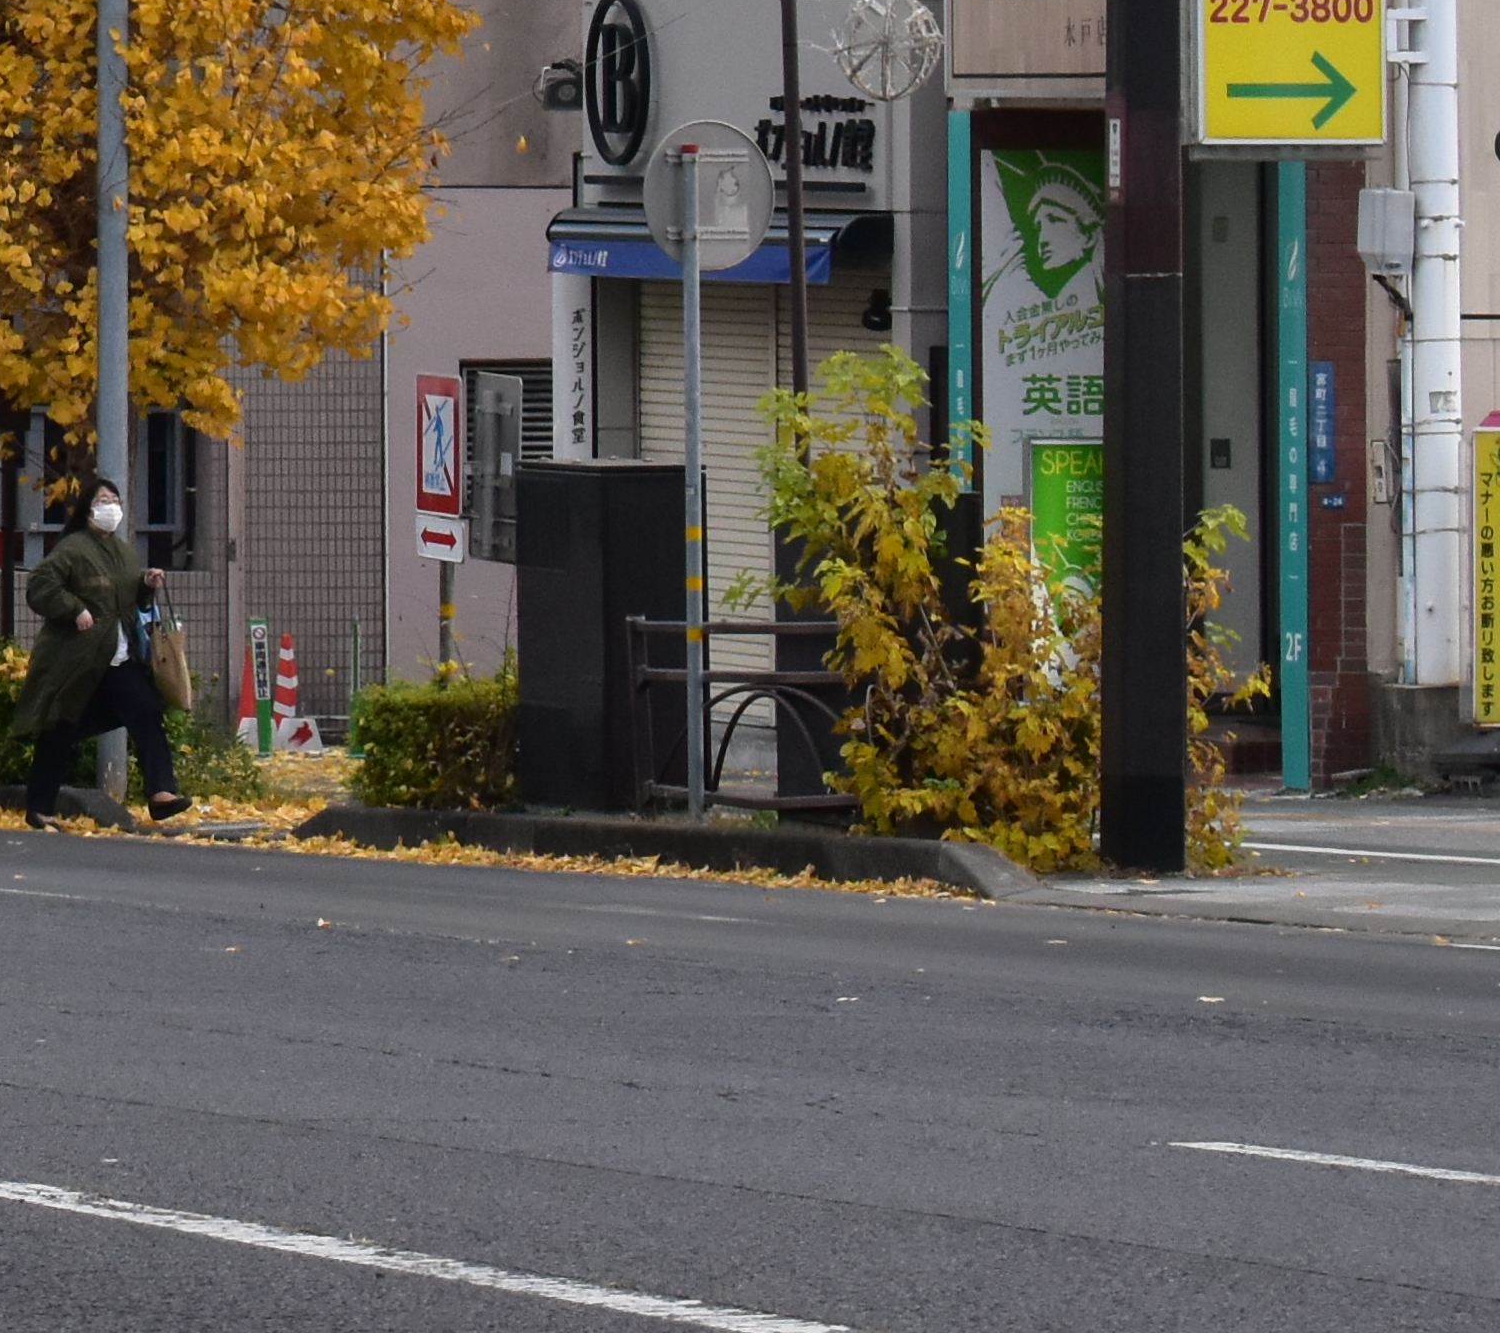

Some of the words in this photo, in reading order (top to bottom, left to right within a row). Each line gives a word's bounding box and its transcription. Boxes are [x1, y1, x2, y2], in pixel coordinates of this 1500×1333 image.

[570, 307, 587, 446] ボンジョルノ食堂
[1040, 450, 1105, 476] SPEA
[1479, 471, 1495, 717] マナーの悪い方お断り致します
